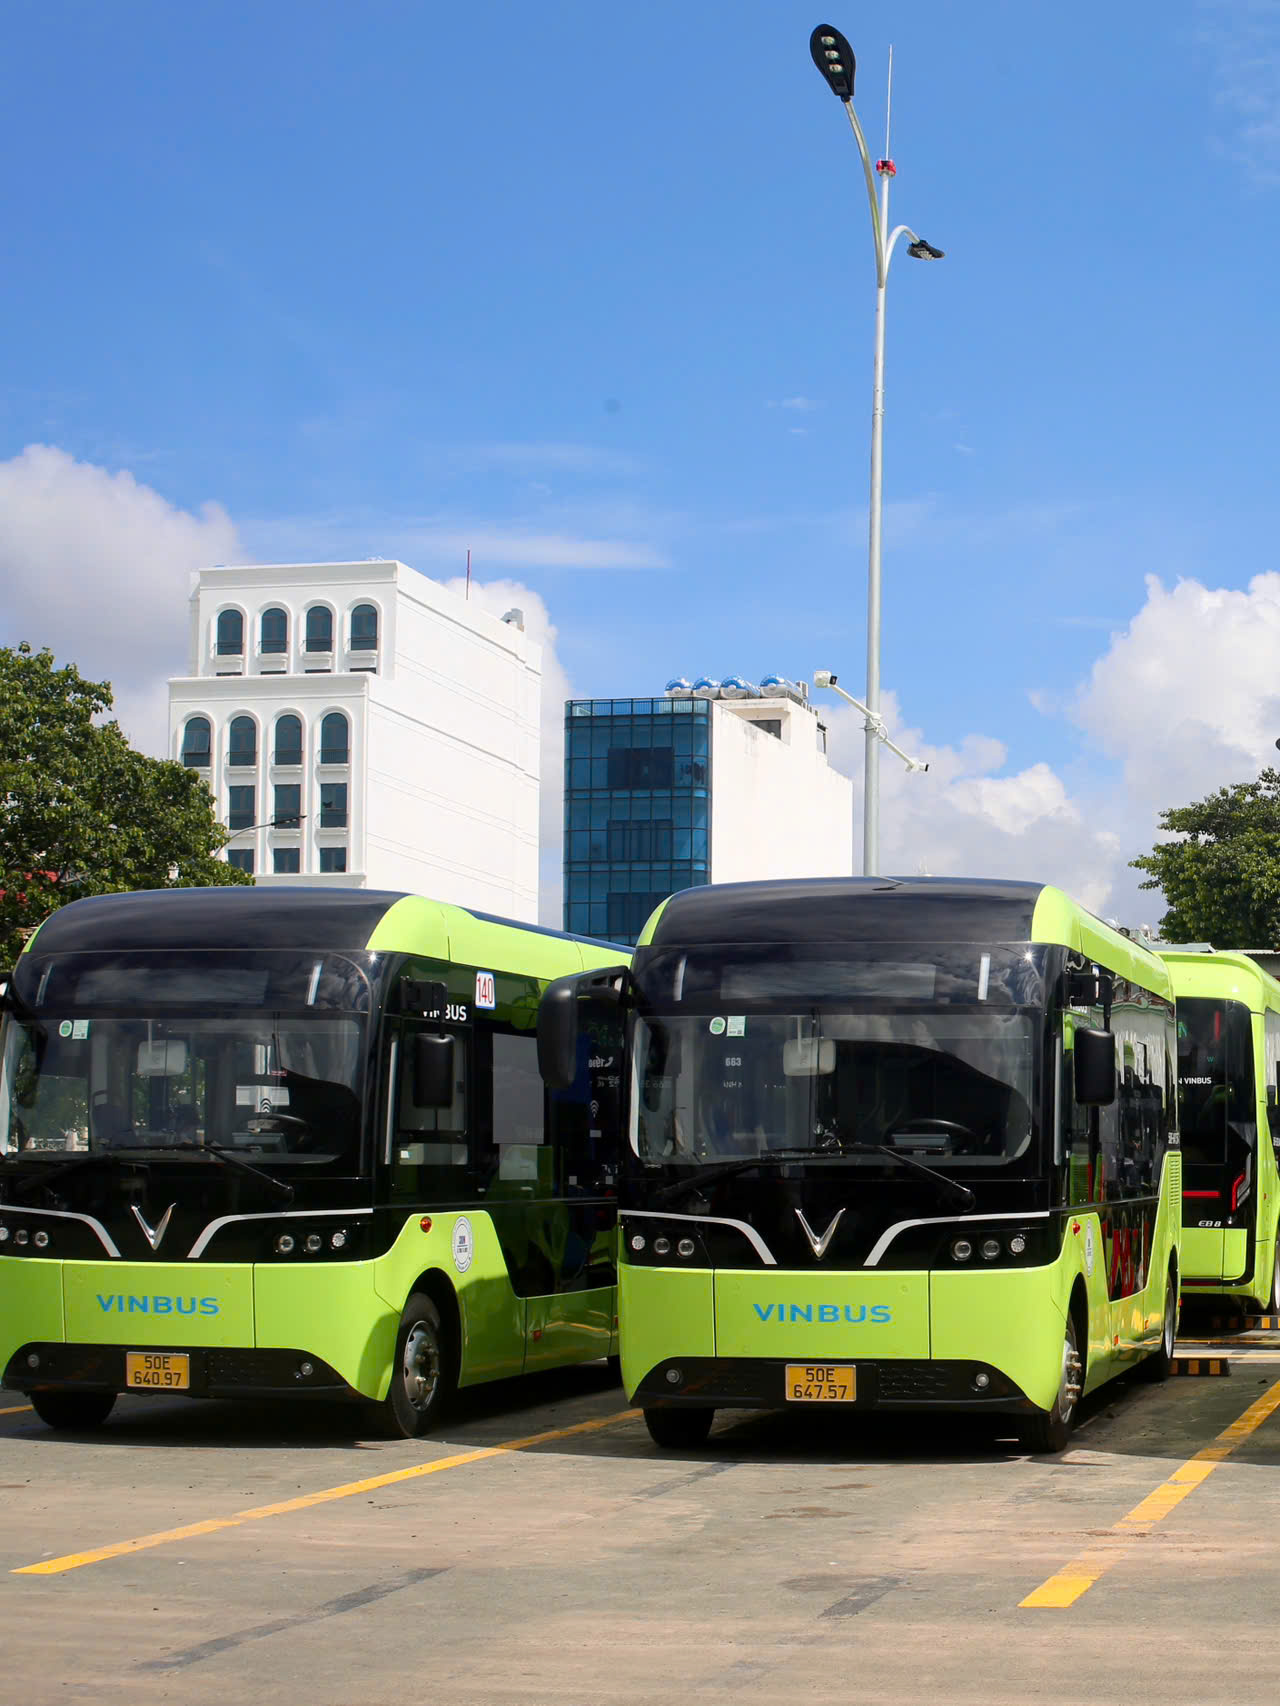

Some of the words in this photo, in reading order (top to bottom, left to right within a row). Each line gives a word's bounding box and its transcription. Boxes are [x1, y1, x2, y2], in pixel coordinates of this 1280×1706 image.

[477, 974, 495, 1005] 140
[423, 1004, 467, 1022] BUS
[1184, 1077, 1212, 1085] VINBUS
[97, 1294, 220, 1316] VINBUS
[754, 1303, 892, 1324] VINBUS
[144, 1355, 171, 1370] 50E
[134, 1370, 182, 1386] 640.97
[805, 1367, 835, 1383] 50E
[794, 1384, 848, 1399] 647.57
